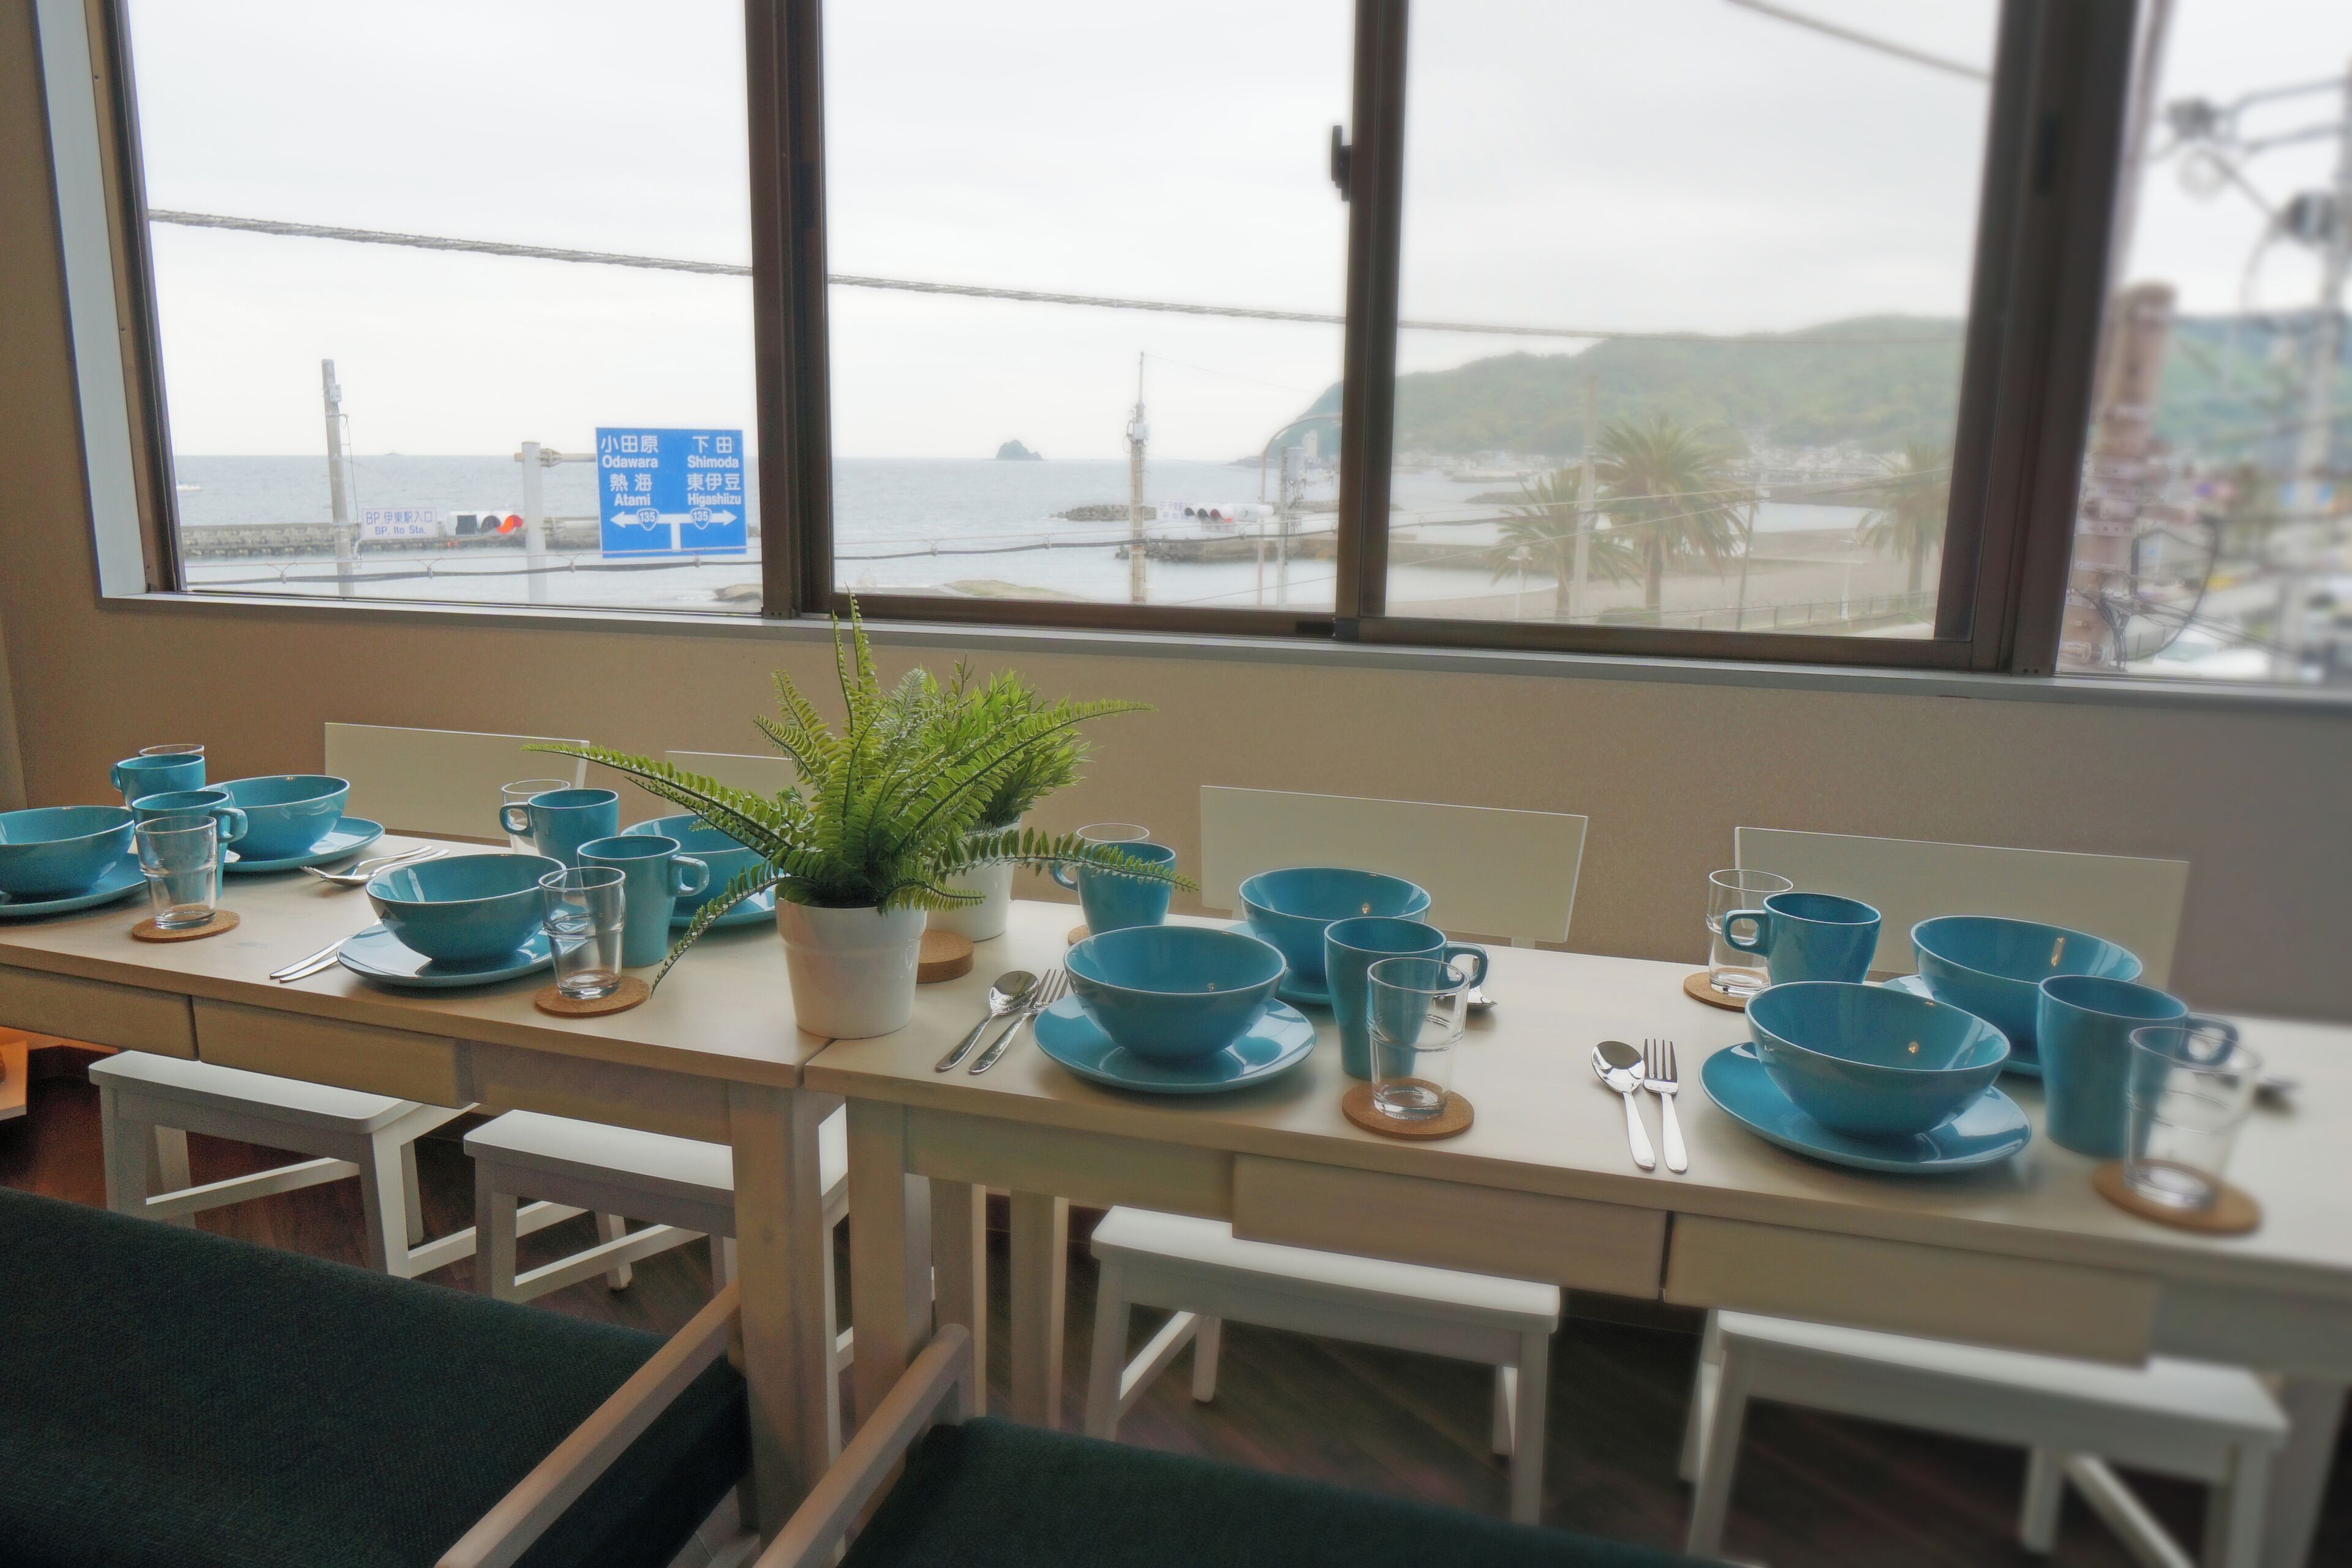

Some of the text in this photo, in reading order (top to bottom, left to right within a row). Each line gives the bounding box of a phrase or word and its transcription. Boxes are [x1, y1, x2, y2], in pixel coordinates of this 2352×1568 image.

[601, 435, 658, 453] 小田原
[692, 436, 733, 454] 下田
[602, 455, 658, 469] Odawara
[687, 455, 739, 469] Shimoda
[609, 473, 652, 491] 熱海
[687, 473, 741, 491] 東伊豆
[614, 493, 650, 506] Atami
[687, 493, 741, 507] Higashiizu
[639, 511, 655, 522] 135
[693, 510, 708, 522] 135
[409, 525, 426, 534] Sta.
